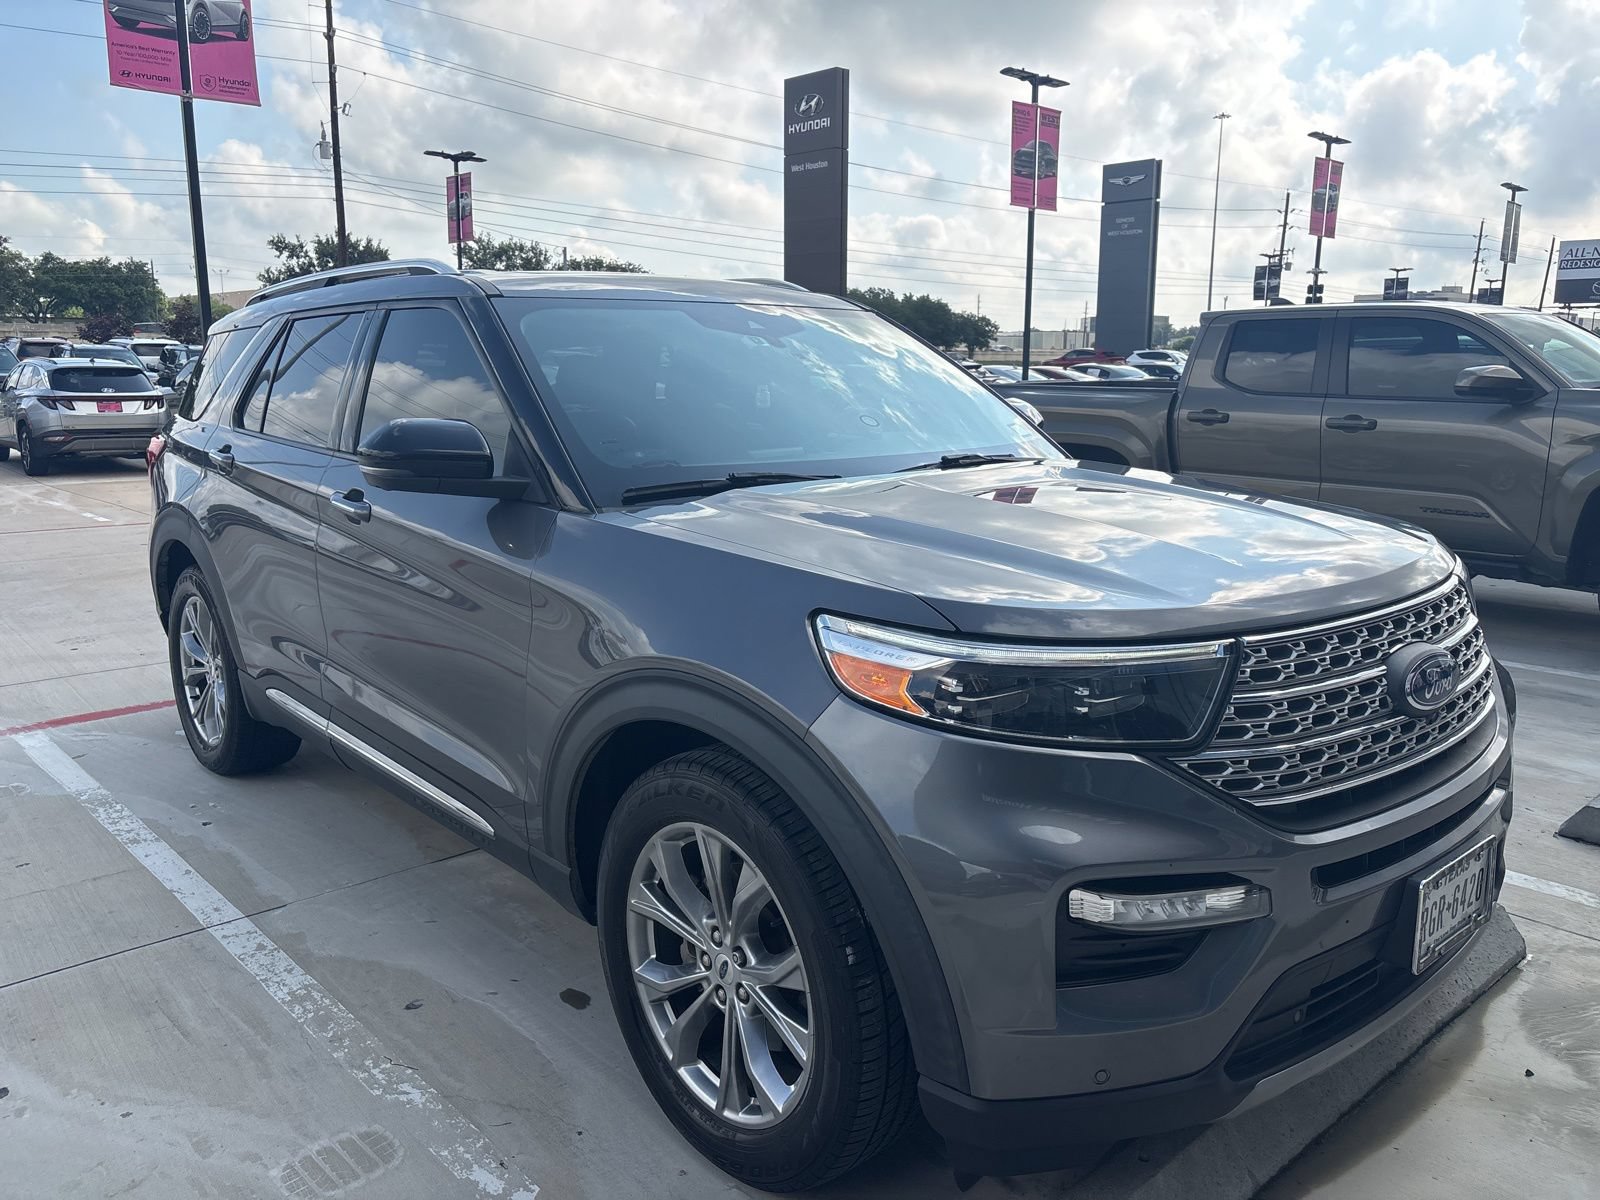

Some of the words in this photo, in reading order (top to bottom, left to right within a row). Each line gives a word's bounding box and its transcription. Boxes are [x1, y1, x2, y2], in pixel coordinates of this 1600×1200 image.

[135, 72, 171, 83] HYUNDAI
[218, 76, 252, 87] Hyundai
[788, 117, 831, 134] HYUNDAI
[791, 163, 805, 172] West
[805, 160, 828, 170] Houston
[1425, 667, 1453, 699] Ford
